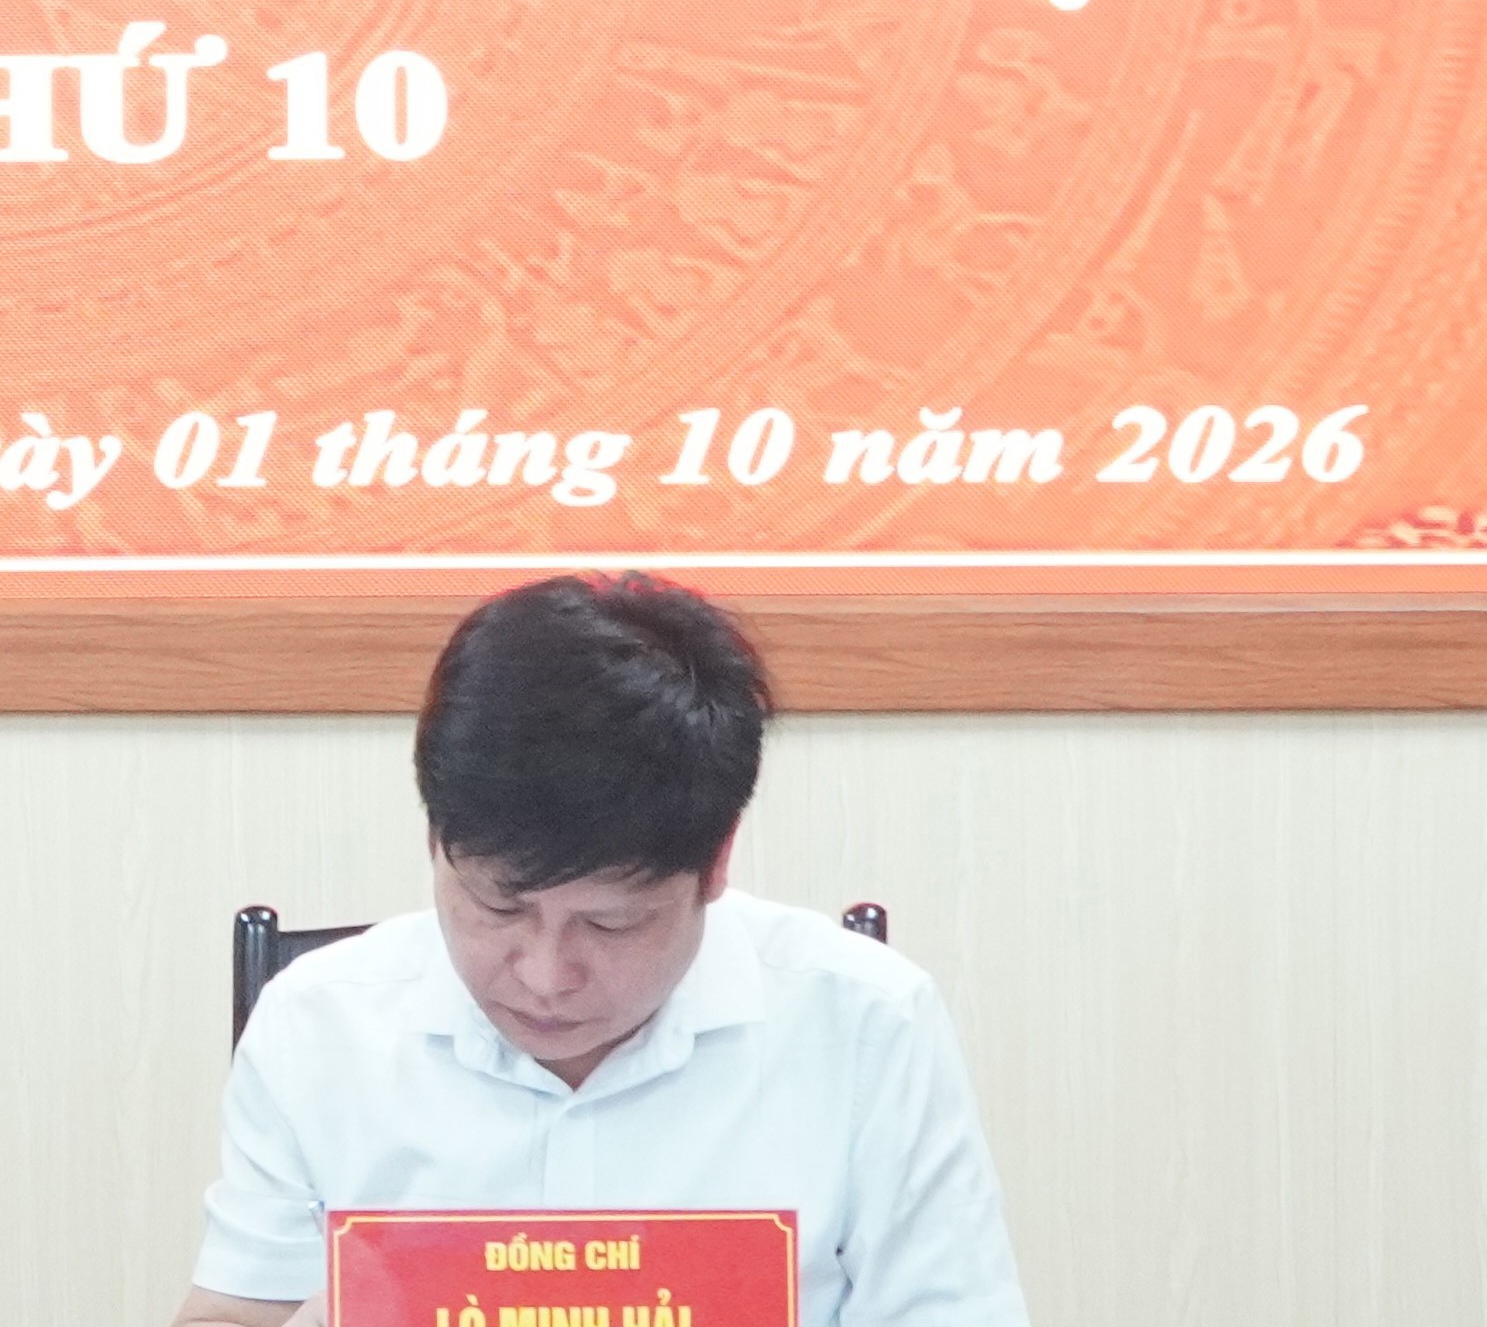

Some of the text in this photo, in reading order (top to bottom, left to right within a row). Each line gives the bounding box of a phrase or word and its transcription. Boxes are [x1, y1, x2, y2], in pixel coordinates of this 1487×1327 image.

[267, 49, 448, 162] 10
[153, 410, 277, 489] 01
[312, 409, 632, 507] tháng
[660, 407, 794, 486] 10
[824, 406, 1063, 484] năm
[1096, 404, 1369, 483] 2026
[484, 1233, 641, 1272] ĐỒNG CHÍ
